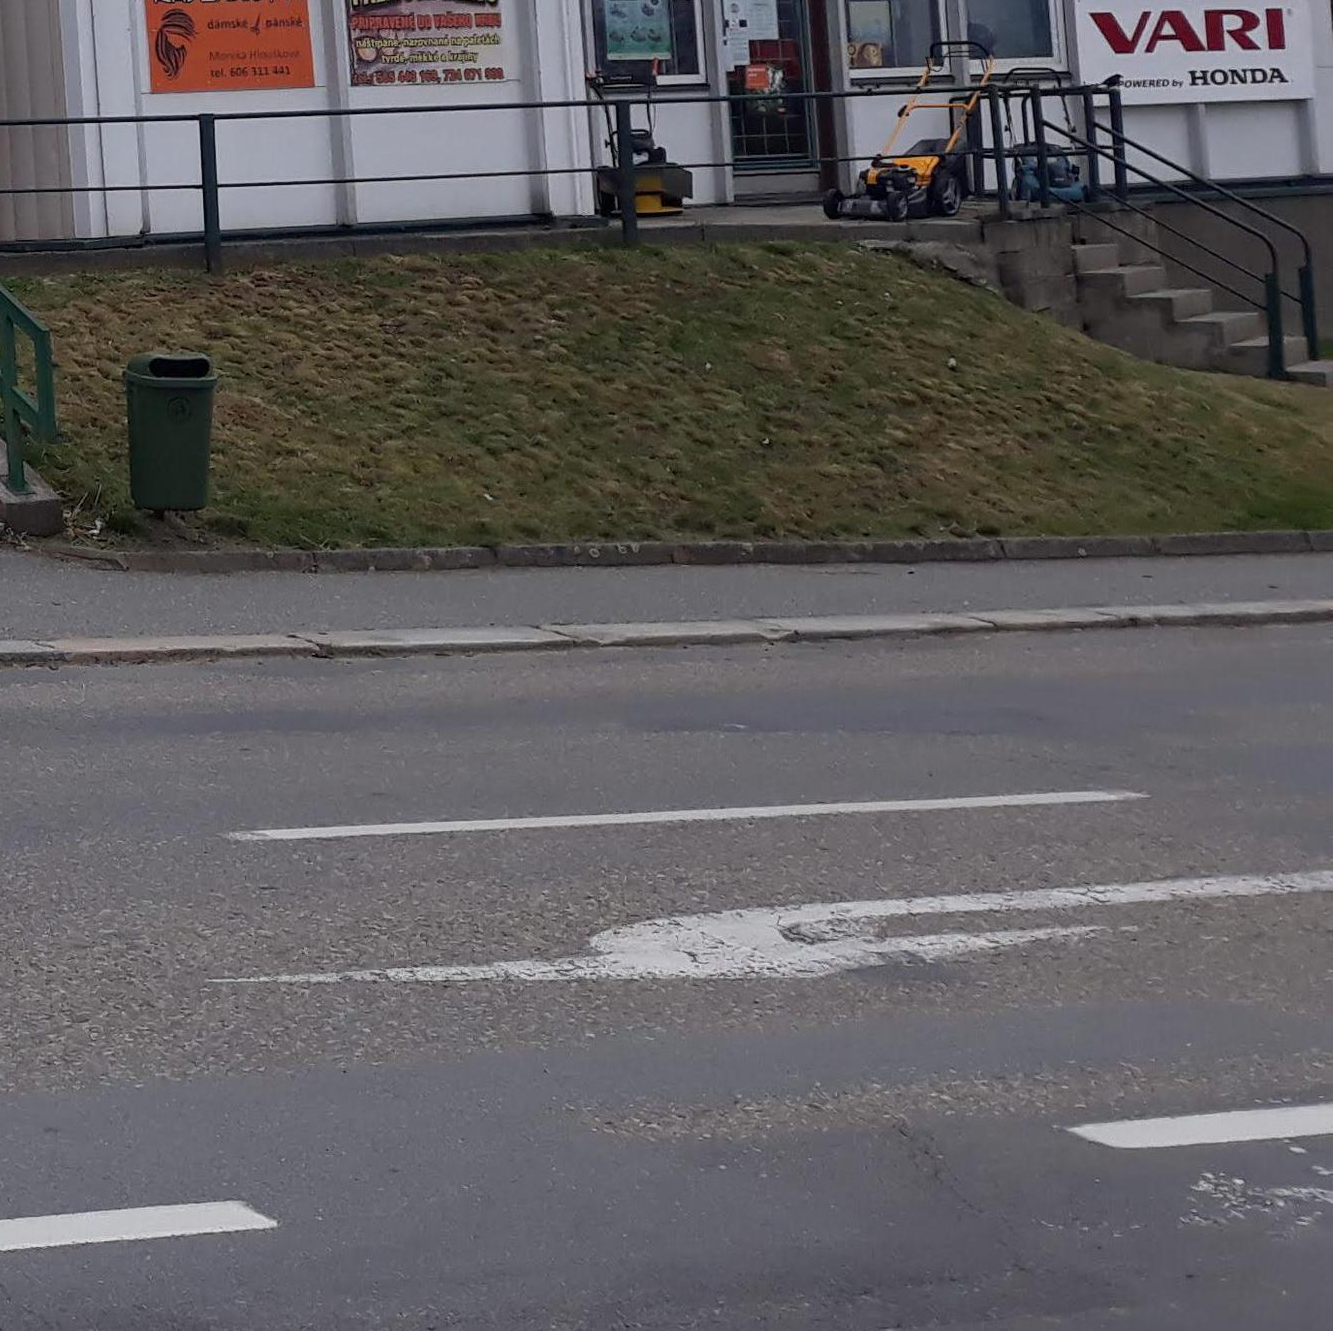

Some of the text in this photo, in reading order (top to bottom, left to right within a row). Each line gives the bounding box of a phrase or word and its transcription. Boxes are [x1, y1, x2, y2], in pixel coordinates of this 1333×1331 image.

[207, 16, 303, 31] dámské pánské
[1089, 8, 1285, 54] VARI
[1118, 68, 1289, 90] POWERED by HONDA
